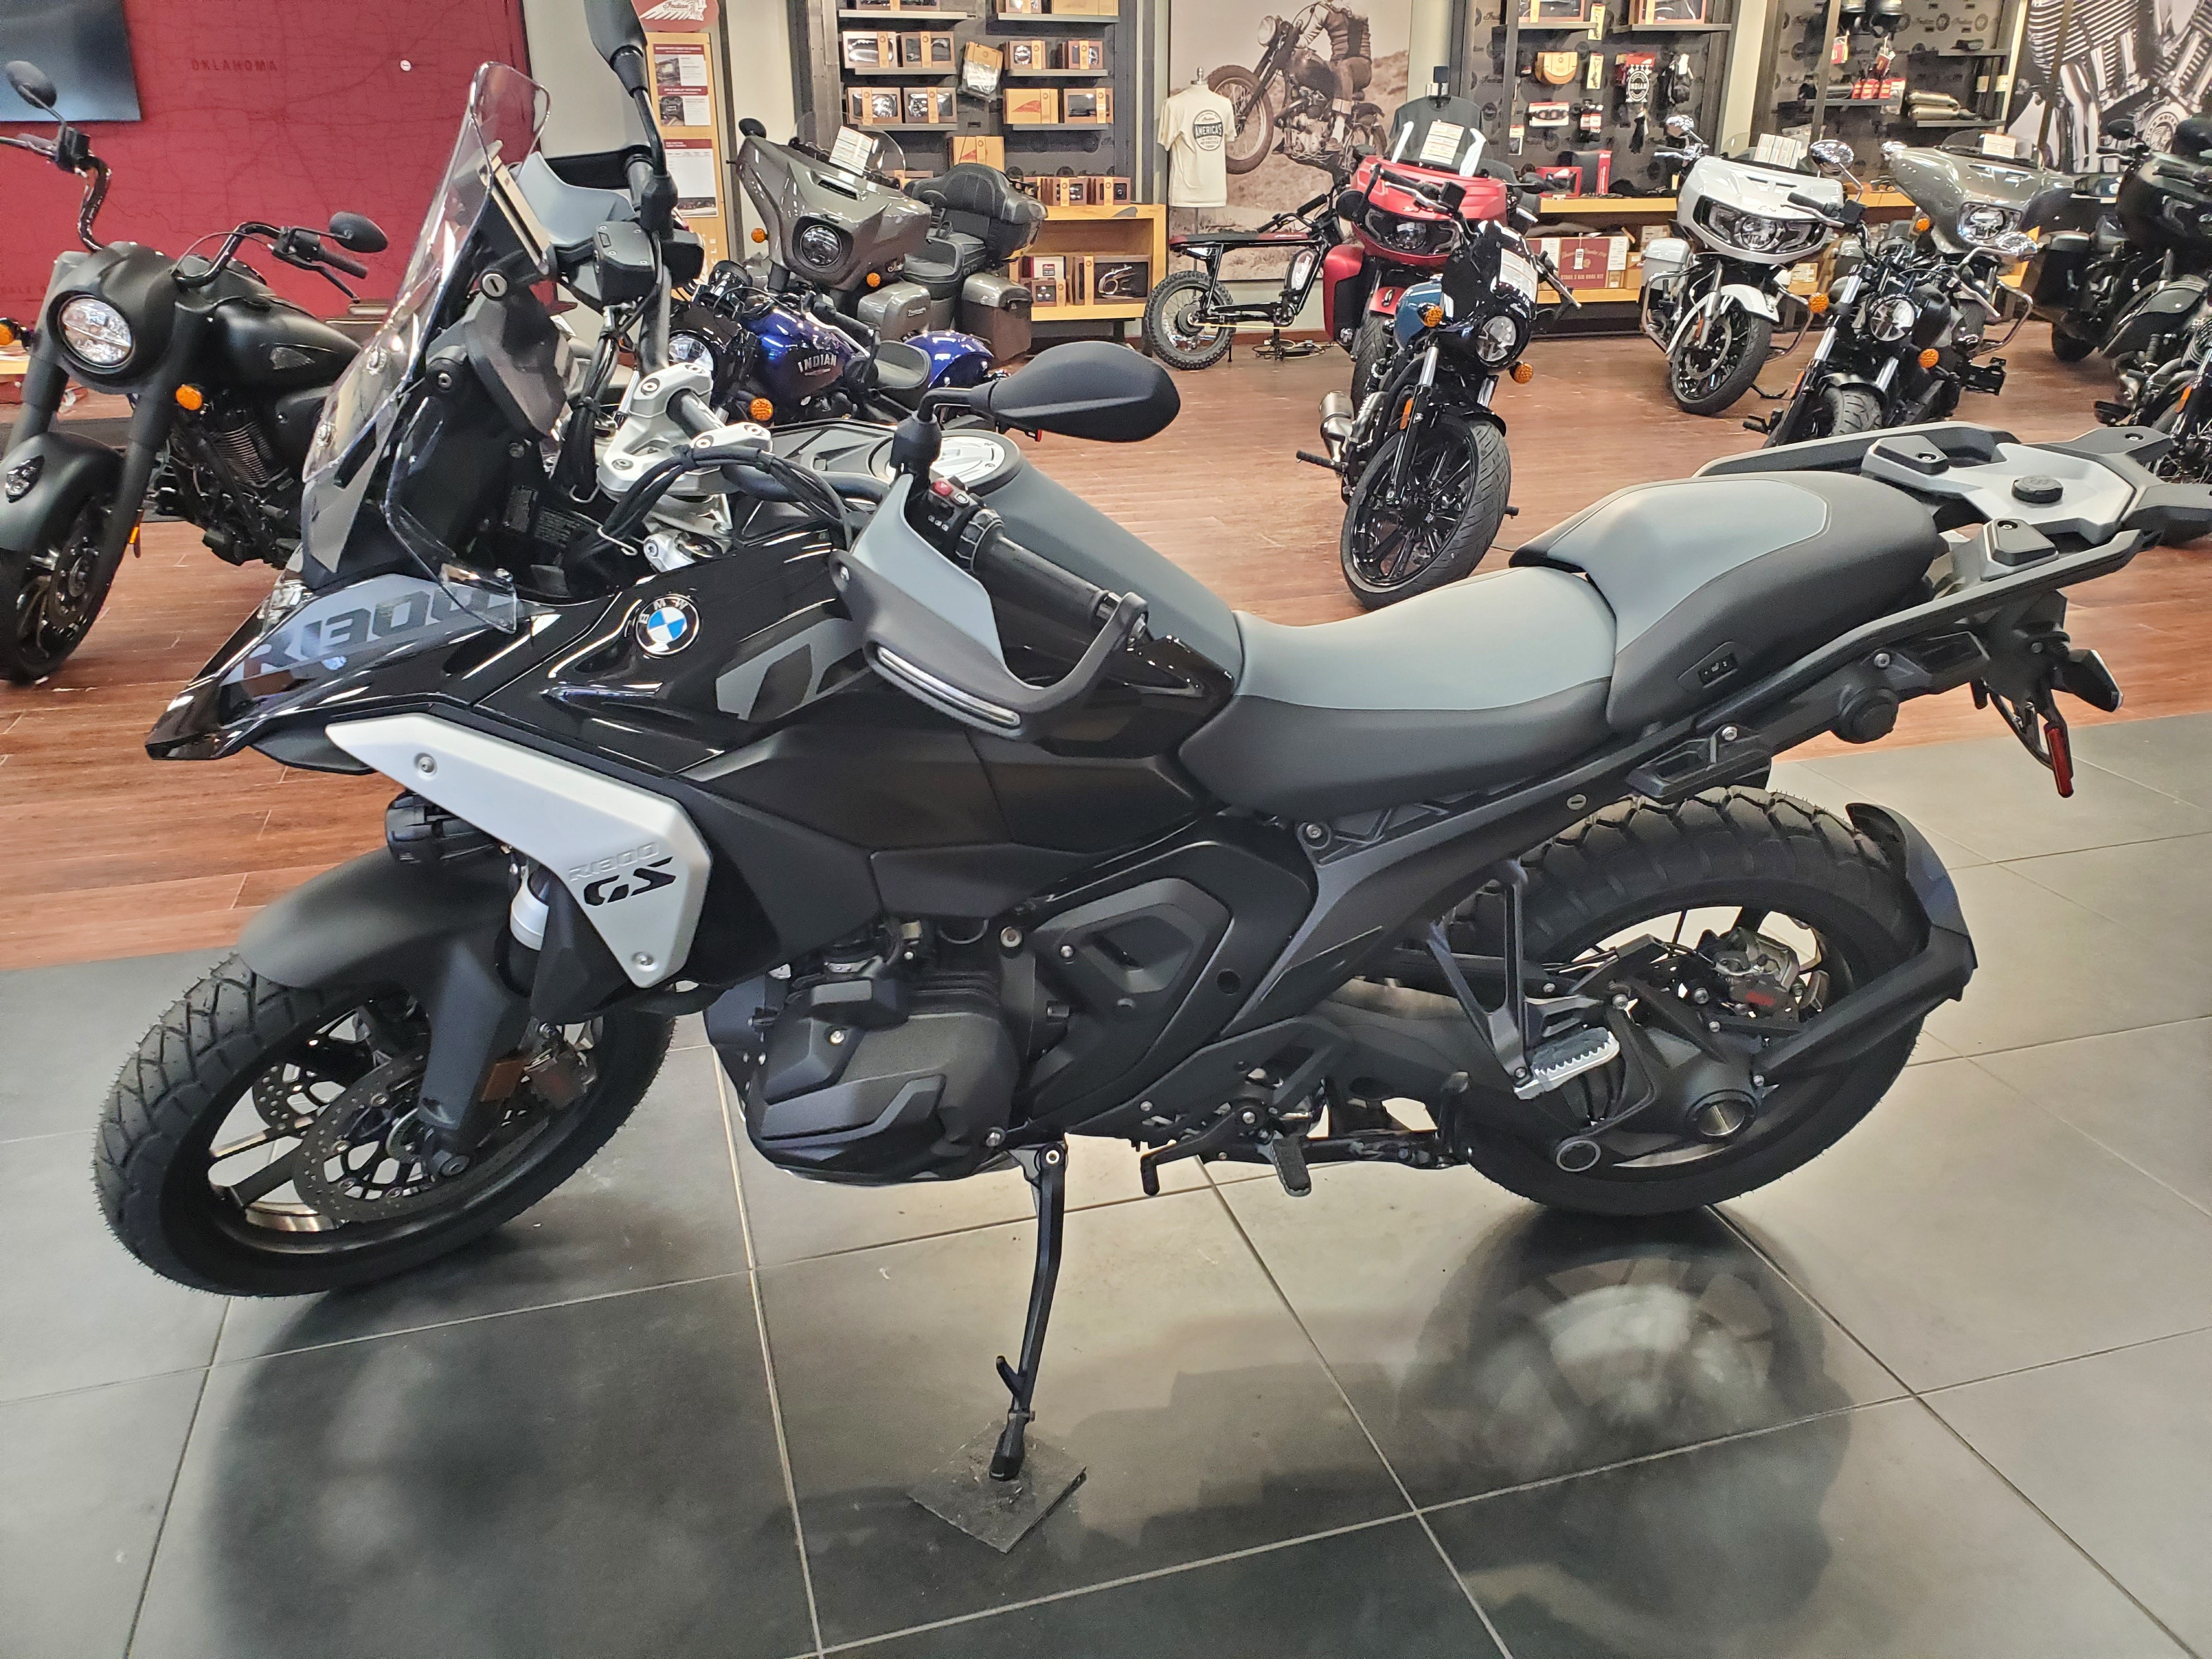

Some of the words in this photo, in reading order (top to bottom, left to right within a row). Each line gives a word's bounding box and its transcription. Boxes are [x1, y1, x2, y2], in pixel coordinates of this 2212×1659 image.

[192, 59, 276, 71] OKLAHOMA
[1295, 255, 1311, 286] Indian
[797, 353, 837, 373] INDIAN
[638, 599, 689, 624] BMW
[583, 856, 676, 907] GS
